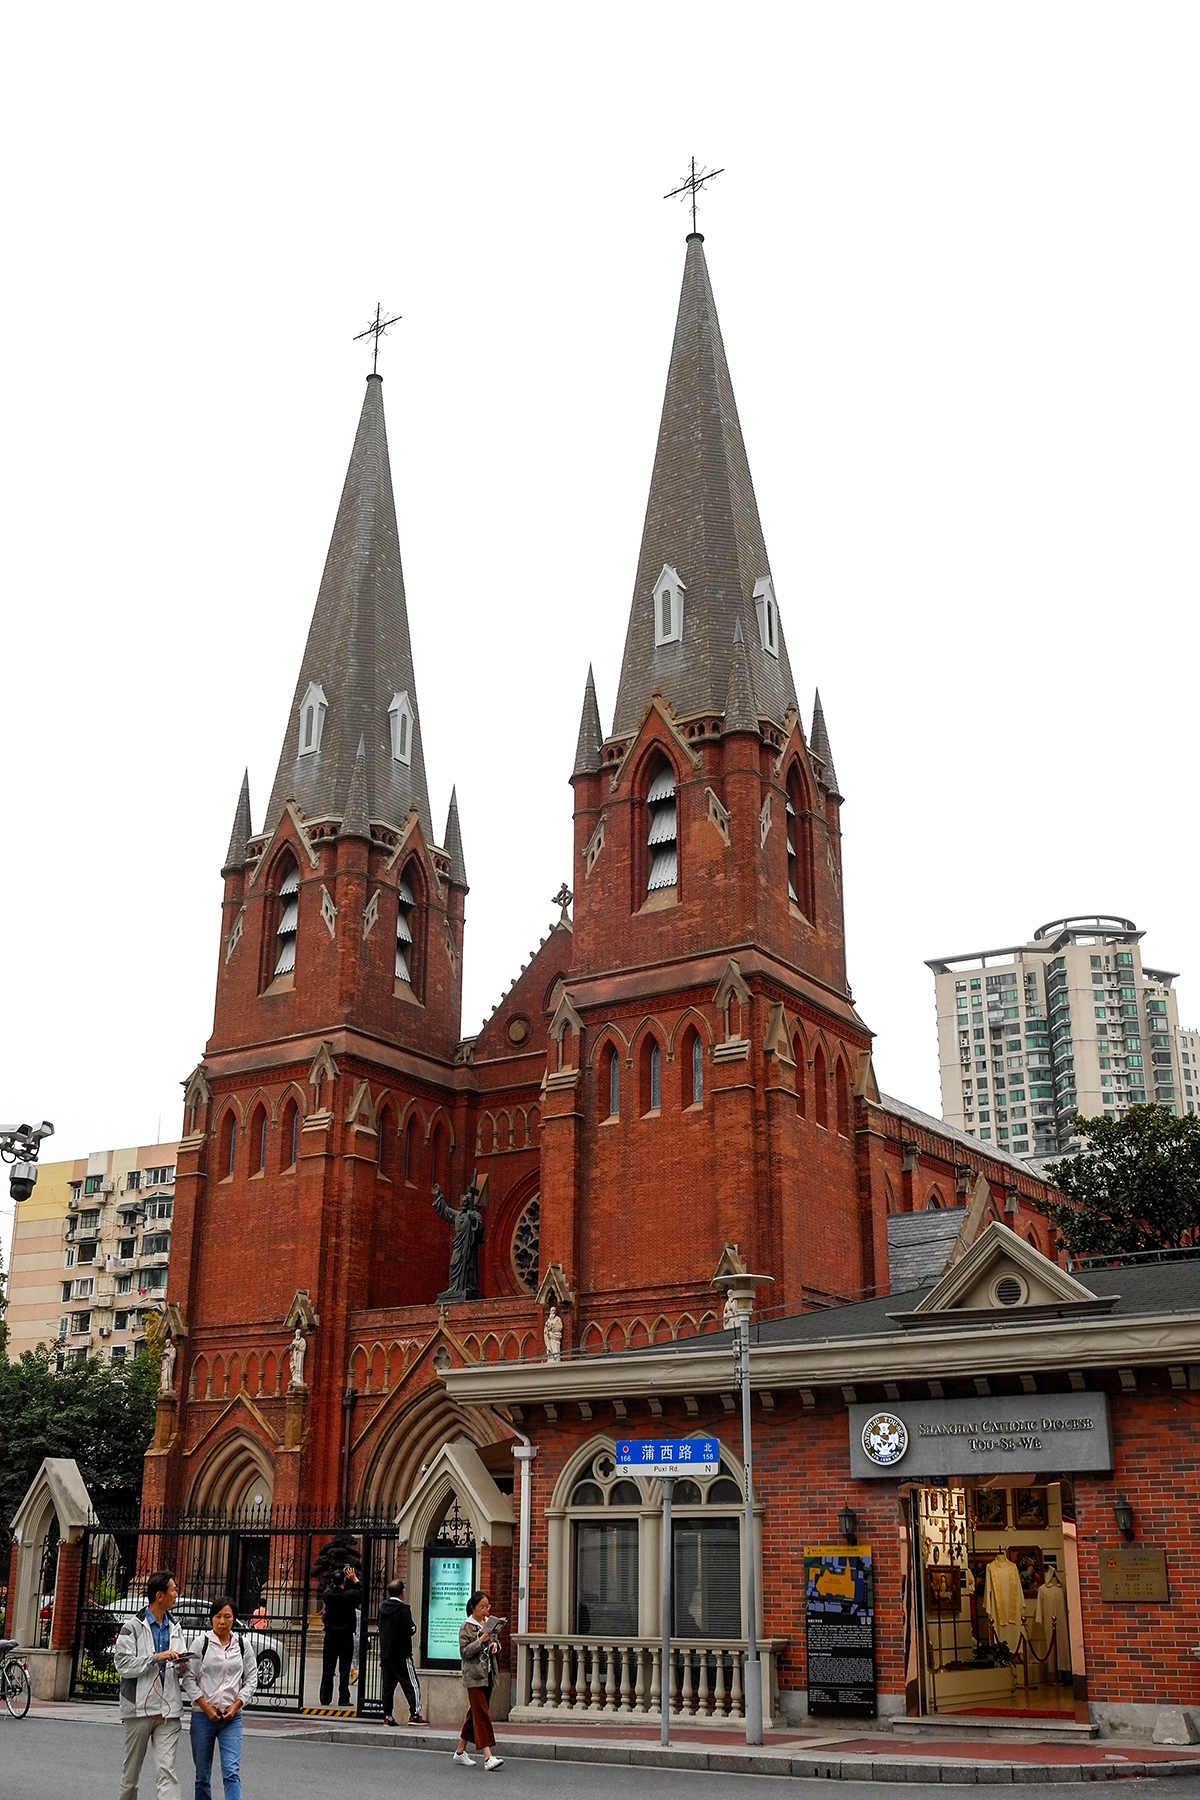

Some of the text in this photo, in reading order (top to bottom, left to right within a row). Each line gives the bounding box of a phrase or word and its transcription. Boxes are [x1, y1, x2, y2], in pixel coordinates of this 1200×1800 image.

[864, 1418, 880, 1450] CATHOLIC
[918, 1416, 1094, 1436] SHANGHAI CATHOLIC DIOCESE
[642, 1444, 692, 1460] 蒲西路
[703, 1443, 713, 1452] 北
[622, 1466, 629, 1474] S
